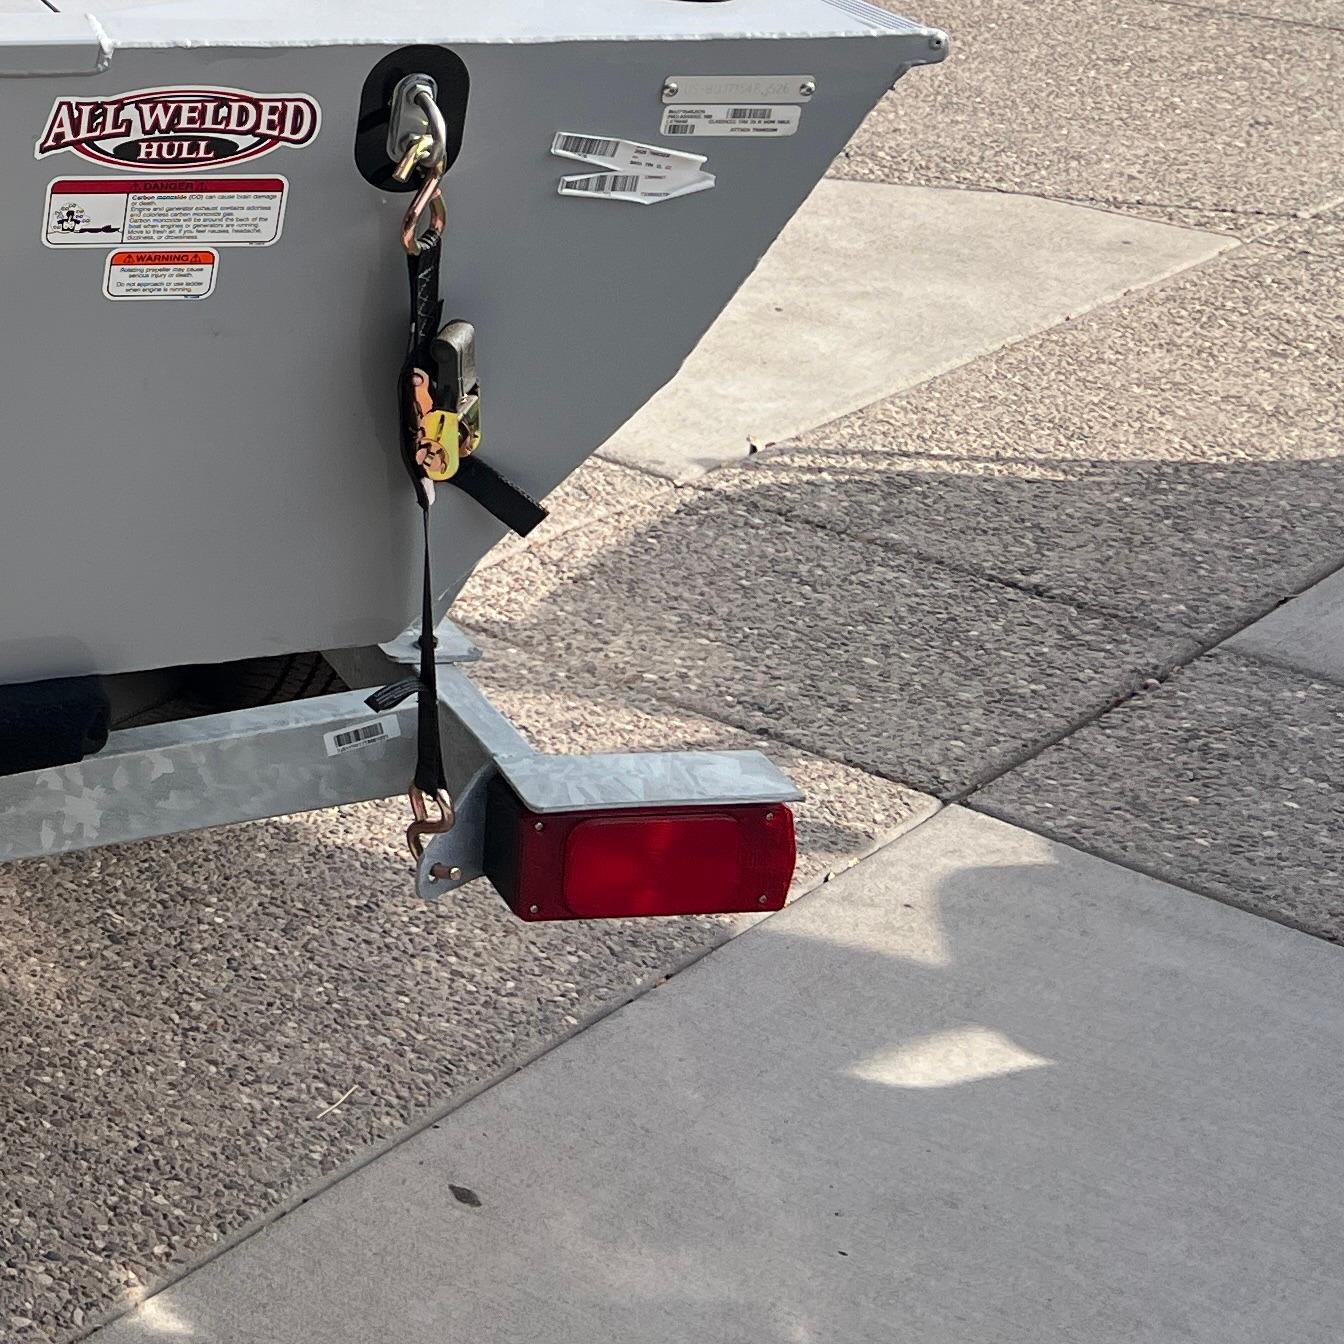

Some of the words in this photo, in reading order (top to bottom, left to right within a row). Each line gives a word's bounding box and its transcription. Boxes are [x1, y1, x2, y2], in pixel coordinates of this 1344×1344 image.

[42, 101, 134, 152] ALL
[134, 98, 317, 145] WELDED
[137, 140, 215, 161] HULL
[143, 181, 194, 191] DANGER
[136, 254, 189, 262] WARNING
